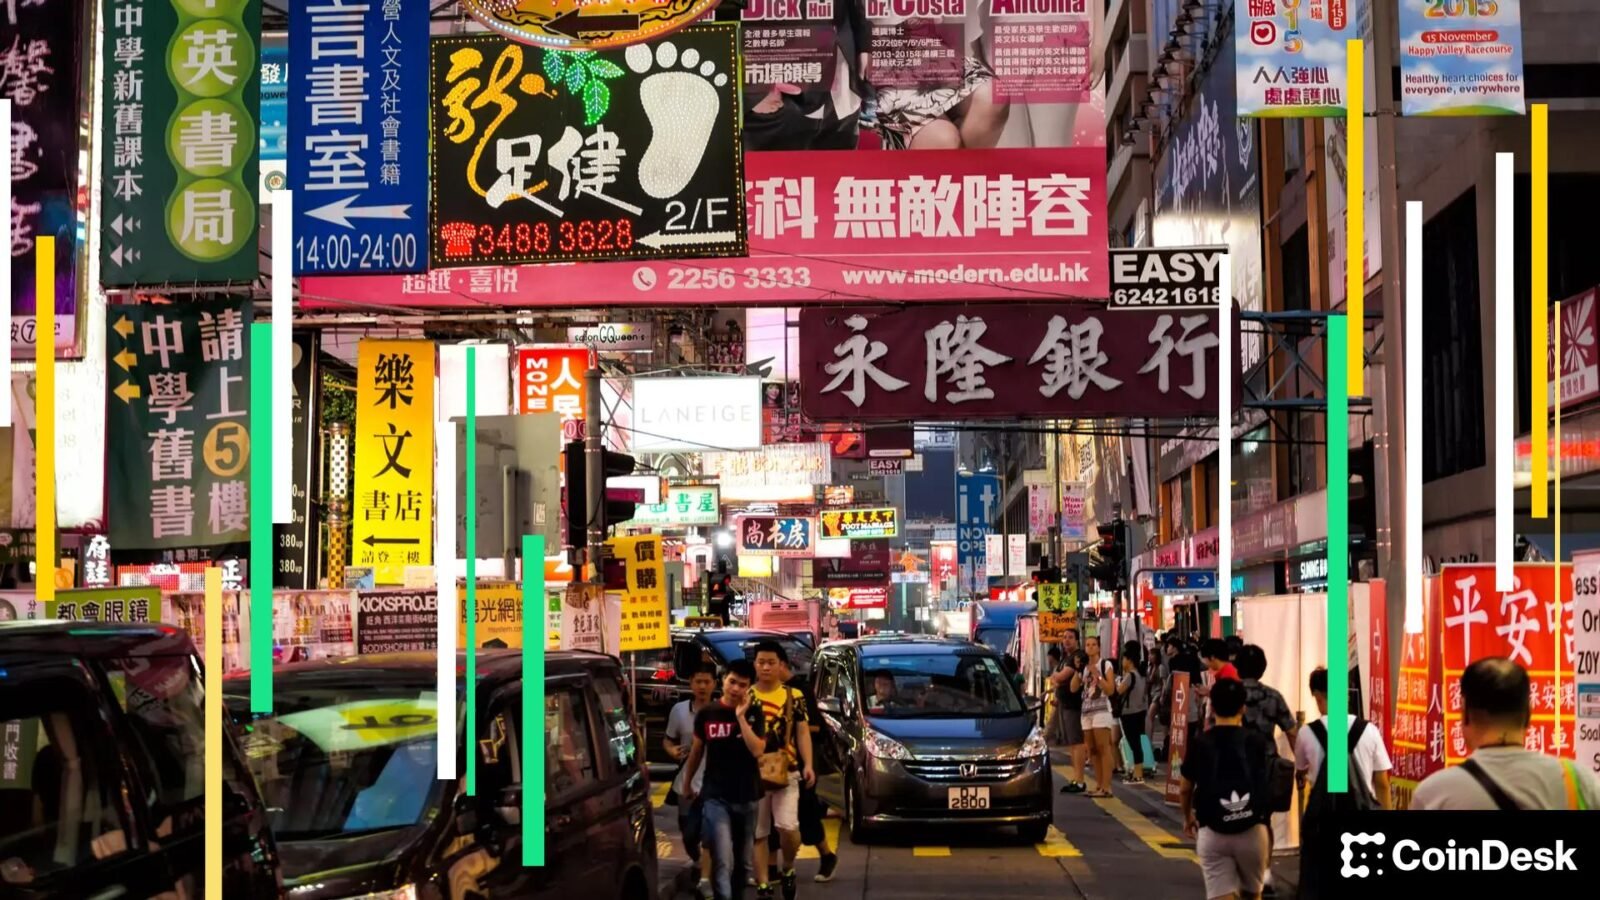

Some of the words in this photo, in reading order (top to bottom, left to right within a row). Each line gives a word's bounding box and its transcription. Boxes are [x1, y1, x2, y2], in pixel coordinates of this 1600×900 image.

[741, 0, 801, 18] Dick
[808, 1, 832, 17] Hui
[867, 0, 889, 17] Dr.
[892, 0, 965, 17] Costa
[991, 0, 1087, 15] Antonia
[1424, 0, 1498, 18] 2015
[1426, 34, 1437, 43] 15
[1439, 32, 1493, 42] November
[1408, 45, 1435, 57] Happy
[1436, 45, 1464, 55] Valley
[1465, 44, 1513, 55] Racecourse
[261, 62, 288, 84] 發
[744, 62, 822, 84] 市場領導
[1253, 66, 1330, 84] 人人強心
[1405, 74, 1440, 84] Healthy
[1442, 73, 1466, 83] heart
[1468, 73, 1504, 82] choices
[1505, 72, 1519, 82] for
[305, 0, 370, 190] 言書室
[1405, 85, 1457, 96] everyone,
[1459, 84, 1520, 95] everywhere
[113, 5, 144, 201] 中學新舊課本
[180, 0, 237, 246] 英書局
[665, 197, 729, 231] 2/F
[833, 173, 1093, 239] 無敵陣容
[478, 222, 551, 256] 3488
[559, 218, 633, 252] 3628
[296, 233, 417, 269] 14:00-24:00
[667, 268, 736, 290] 2256
[743, 267, 811, 289] 3333
[842, 262, 1090, 285] www.modern.edu.hk
[1113, 252, 1220, 284] EASY
[1114, 286, 1220, 305] 62421618
[819, 314, 1220, 408] 永隆銀行
[526, 357, 549, 415] MONE
[198, 308, 250, 535] 請上5樓
[641, 405, 753, 425] LANEIGE
[141, 315, 195, 539] 中學舊書
[870, 460, 900, 469] EASY
[362, 490, 423, 522] 書店
[960, 527, 995, 540] NOW
[960, 541, 985, 552] OPE
[58, 599, 149, 623] 都會眼鏡
[358, 595, 438, 612] KICKSPROJE
